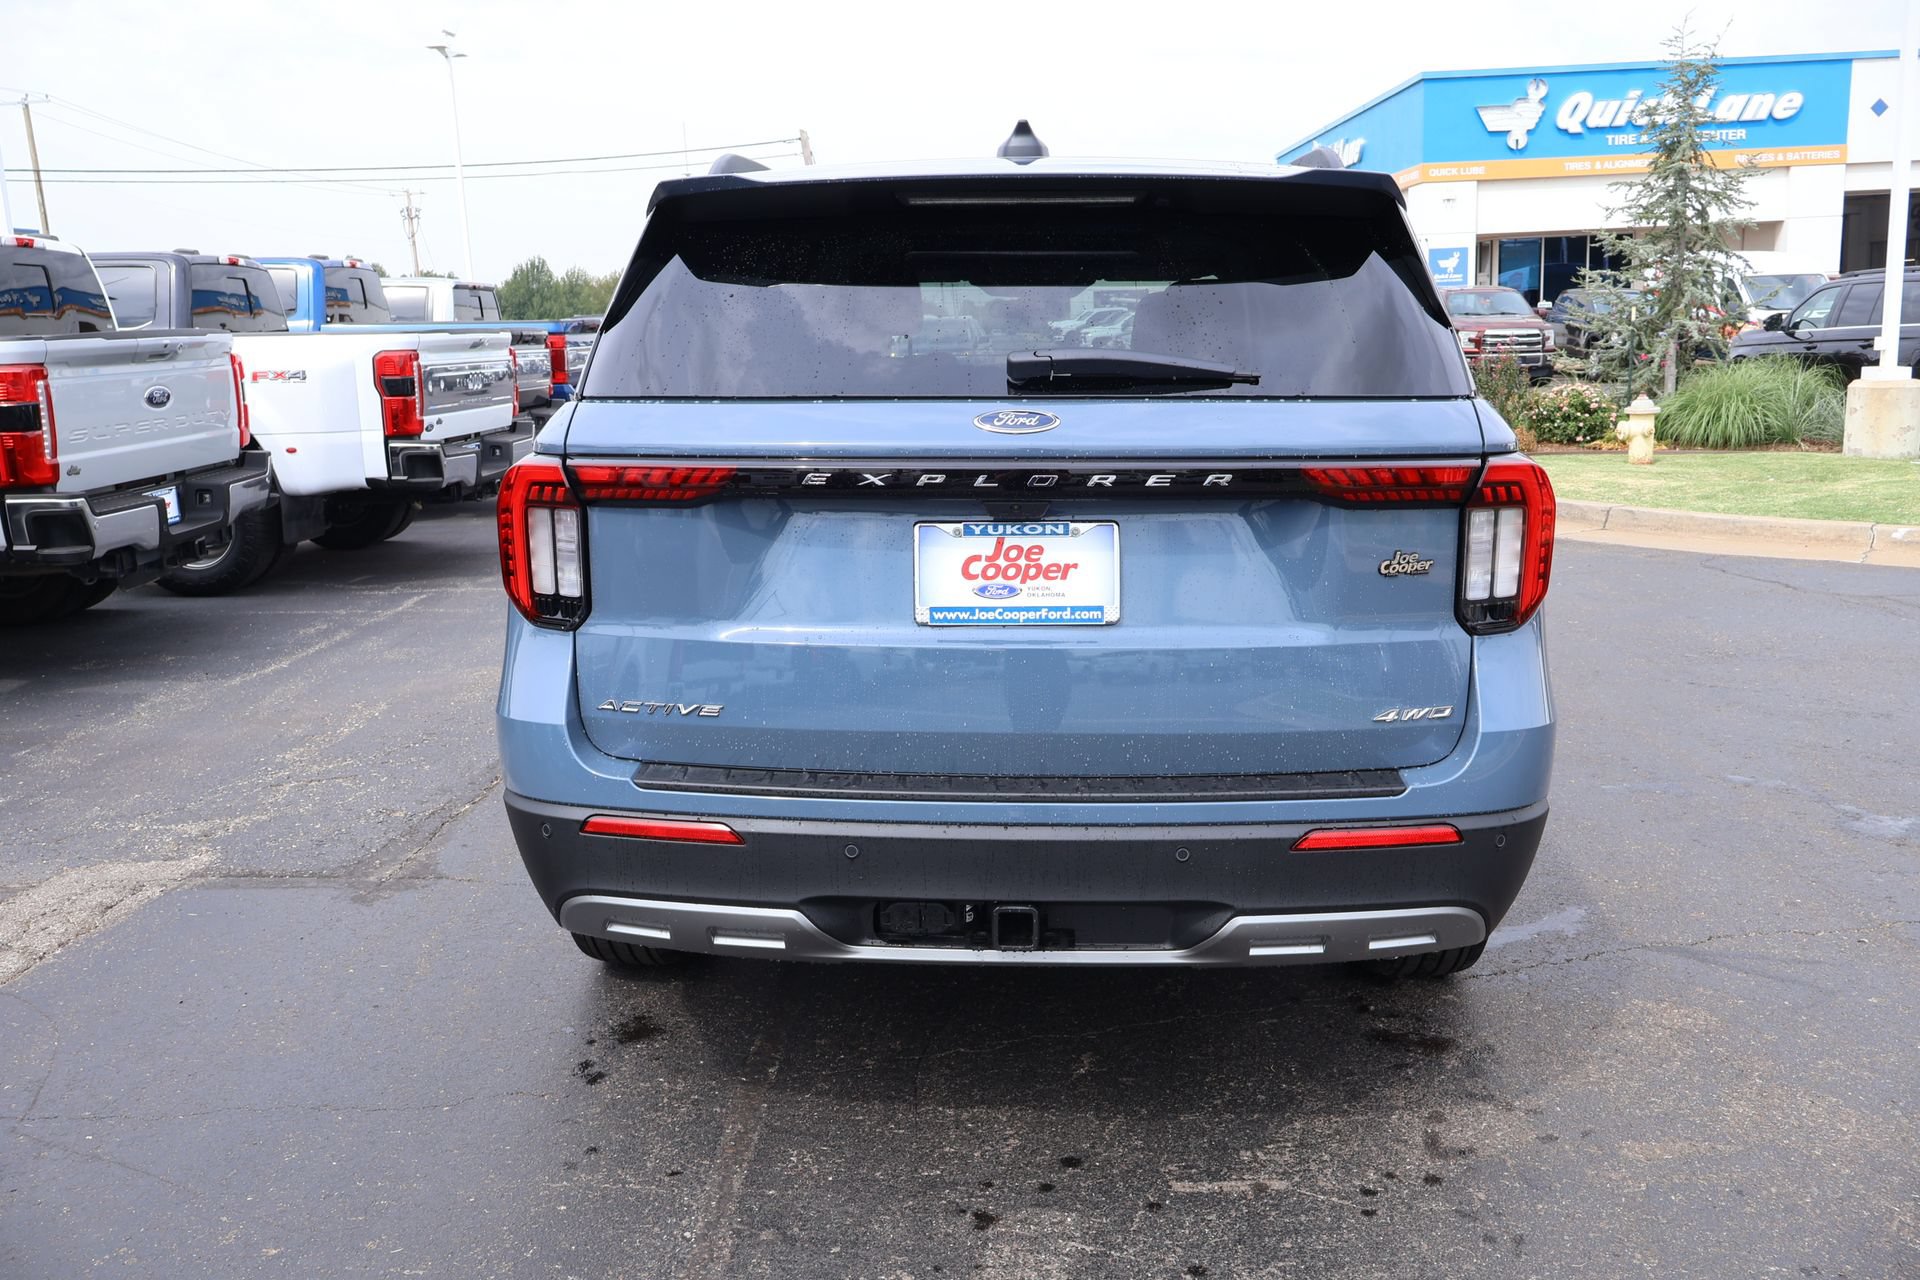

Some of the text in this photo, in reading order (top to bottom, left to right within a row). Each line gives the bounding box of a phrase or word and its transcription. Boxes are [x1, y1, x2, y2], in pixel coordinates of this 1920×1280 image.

[1606, 134, 1637, 146] TIRE
[1787, 150, 1841, 161] BATTERIES
[1428, 168, 1458, 177] QUICK
[1460, 166, 1486, 176] LUBE
[1564, 161, 1592, 172] TIRES
[251, 370, 306, 383] FX4
[993, 411, 1040, 426] Ford
[69, 409, 232, 444] SUPER DUTY
[801, 473, 1234, 488] EXPLORER
[969, 524, 1065, 535] YUKON
[985, 537, 1044, 563] Joe
[1391, 551, 1419, 564] Joe
[961, 555, 1078, 584] Cooper
[1380, 560, 1433, 574] Cooper
[984, 584, 1010, 595] Ford
[932, 608, 1102, 622] www.JoeCooperFord.com
[597, 699, 724, 717] ACTIVE
[1373, 705, 1454, 722] 4WD
